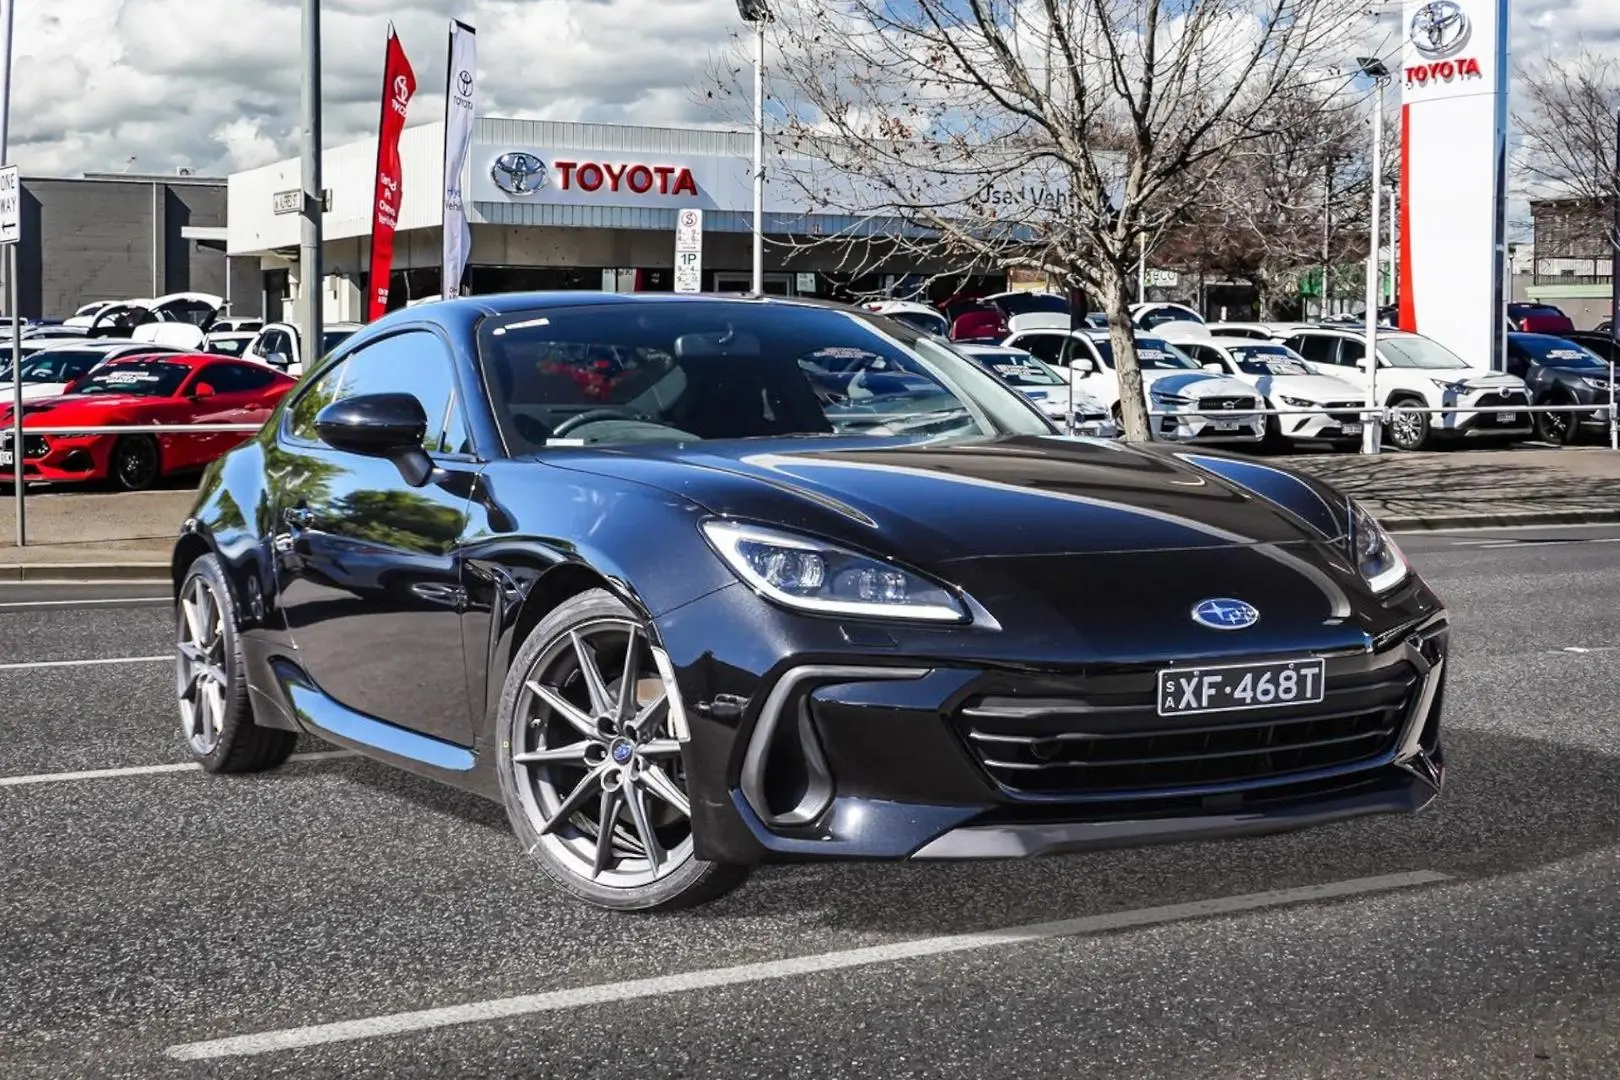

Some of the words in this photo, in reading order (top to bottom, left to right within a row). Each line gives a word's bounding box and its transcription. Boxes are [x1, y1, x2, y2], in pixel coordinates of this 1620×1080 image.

[1404, 58, 1480, 82] TOYOTA
[555, 161, 698, 196] TOYOTA
[977, 185, 1025, 205] Used
[681, 253, 697, 265] 1P
